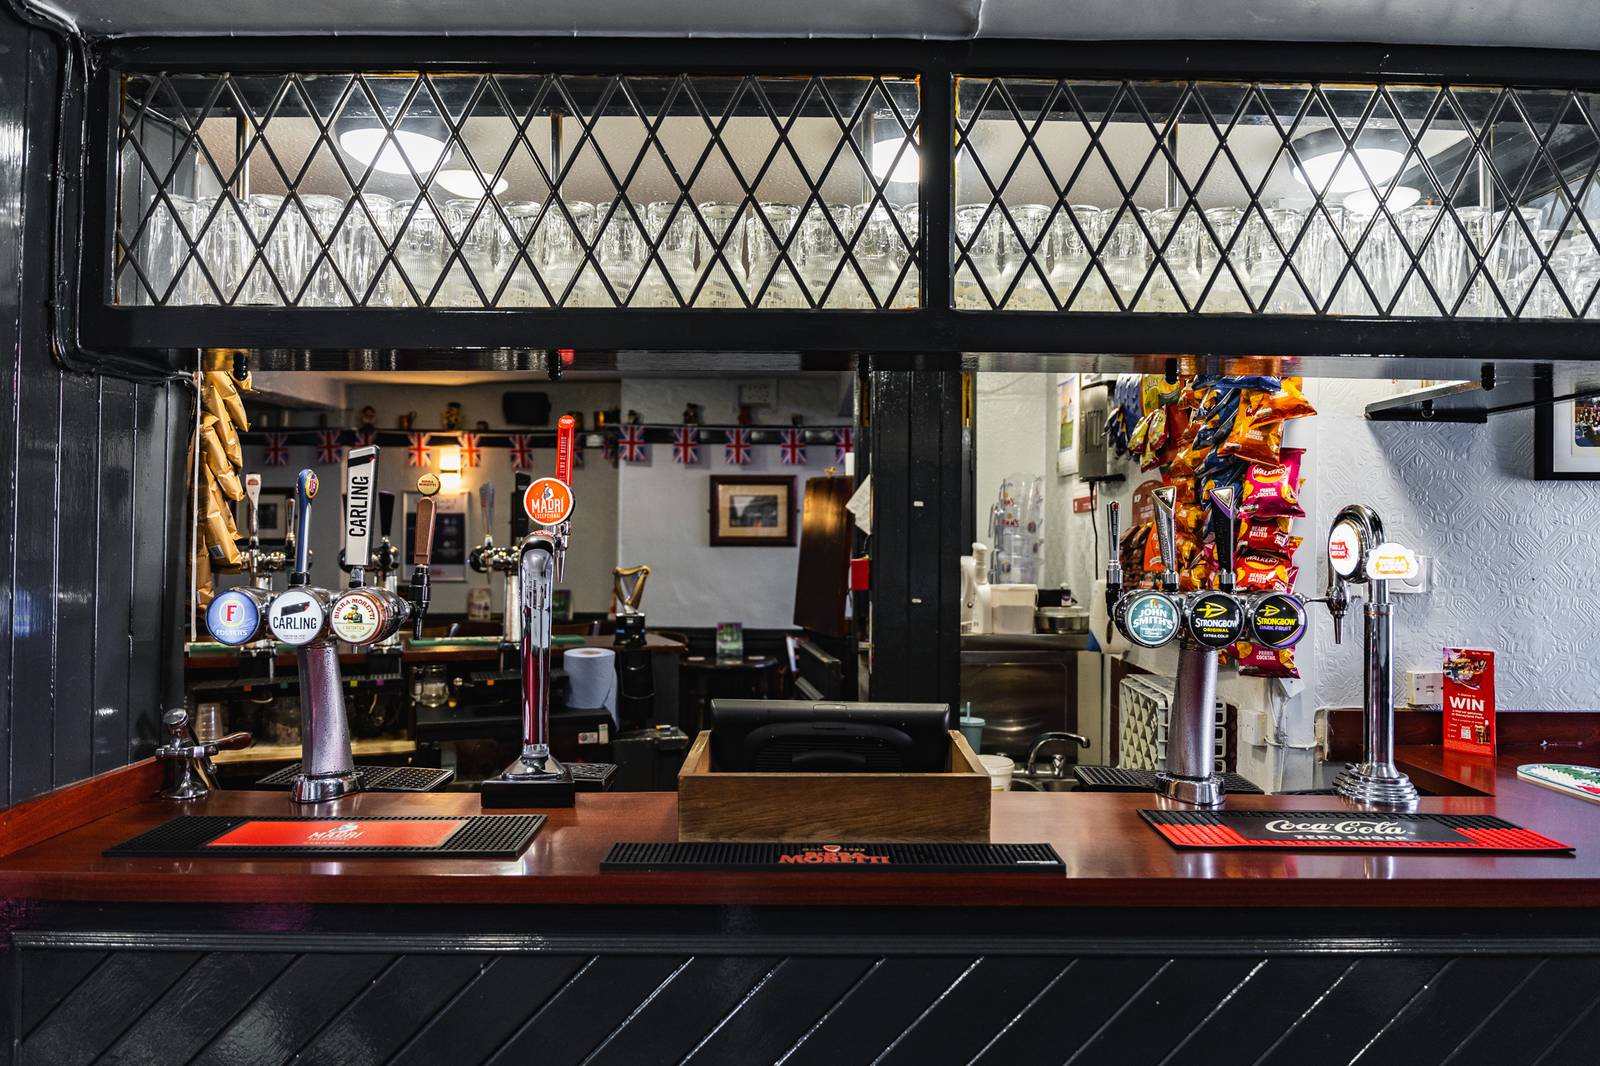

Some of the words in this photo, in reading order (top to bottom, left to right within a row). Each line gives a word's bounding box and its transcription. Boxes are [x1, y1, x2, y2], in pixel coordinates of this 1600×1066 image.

[1254, 468, 1286, 476] WALKERS
[349, 476, 369, 537] CARLING
[1249, 530, 1268, 538] SALTED
[226, 605, 237, 622] F
[334, 599, 351, 619] BIRRA
[351, 598, 375, 620] MORETTI
[1138, 608, 1168, 618] JOHN
[272, 616, 317, 630] CARLING
[1195, 617, 1239, 628] STRONGBOW
[1257, 616, 1297, 626] STRONGBOW
[1449, 696, 1485, 712] WIN
[1264, 819, 1407, 835] Coca-Cola
[779, 854, 890, 864] MORETTI
